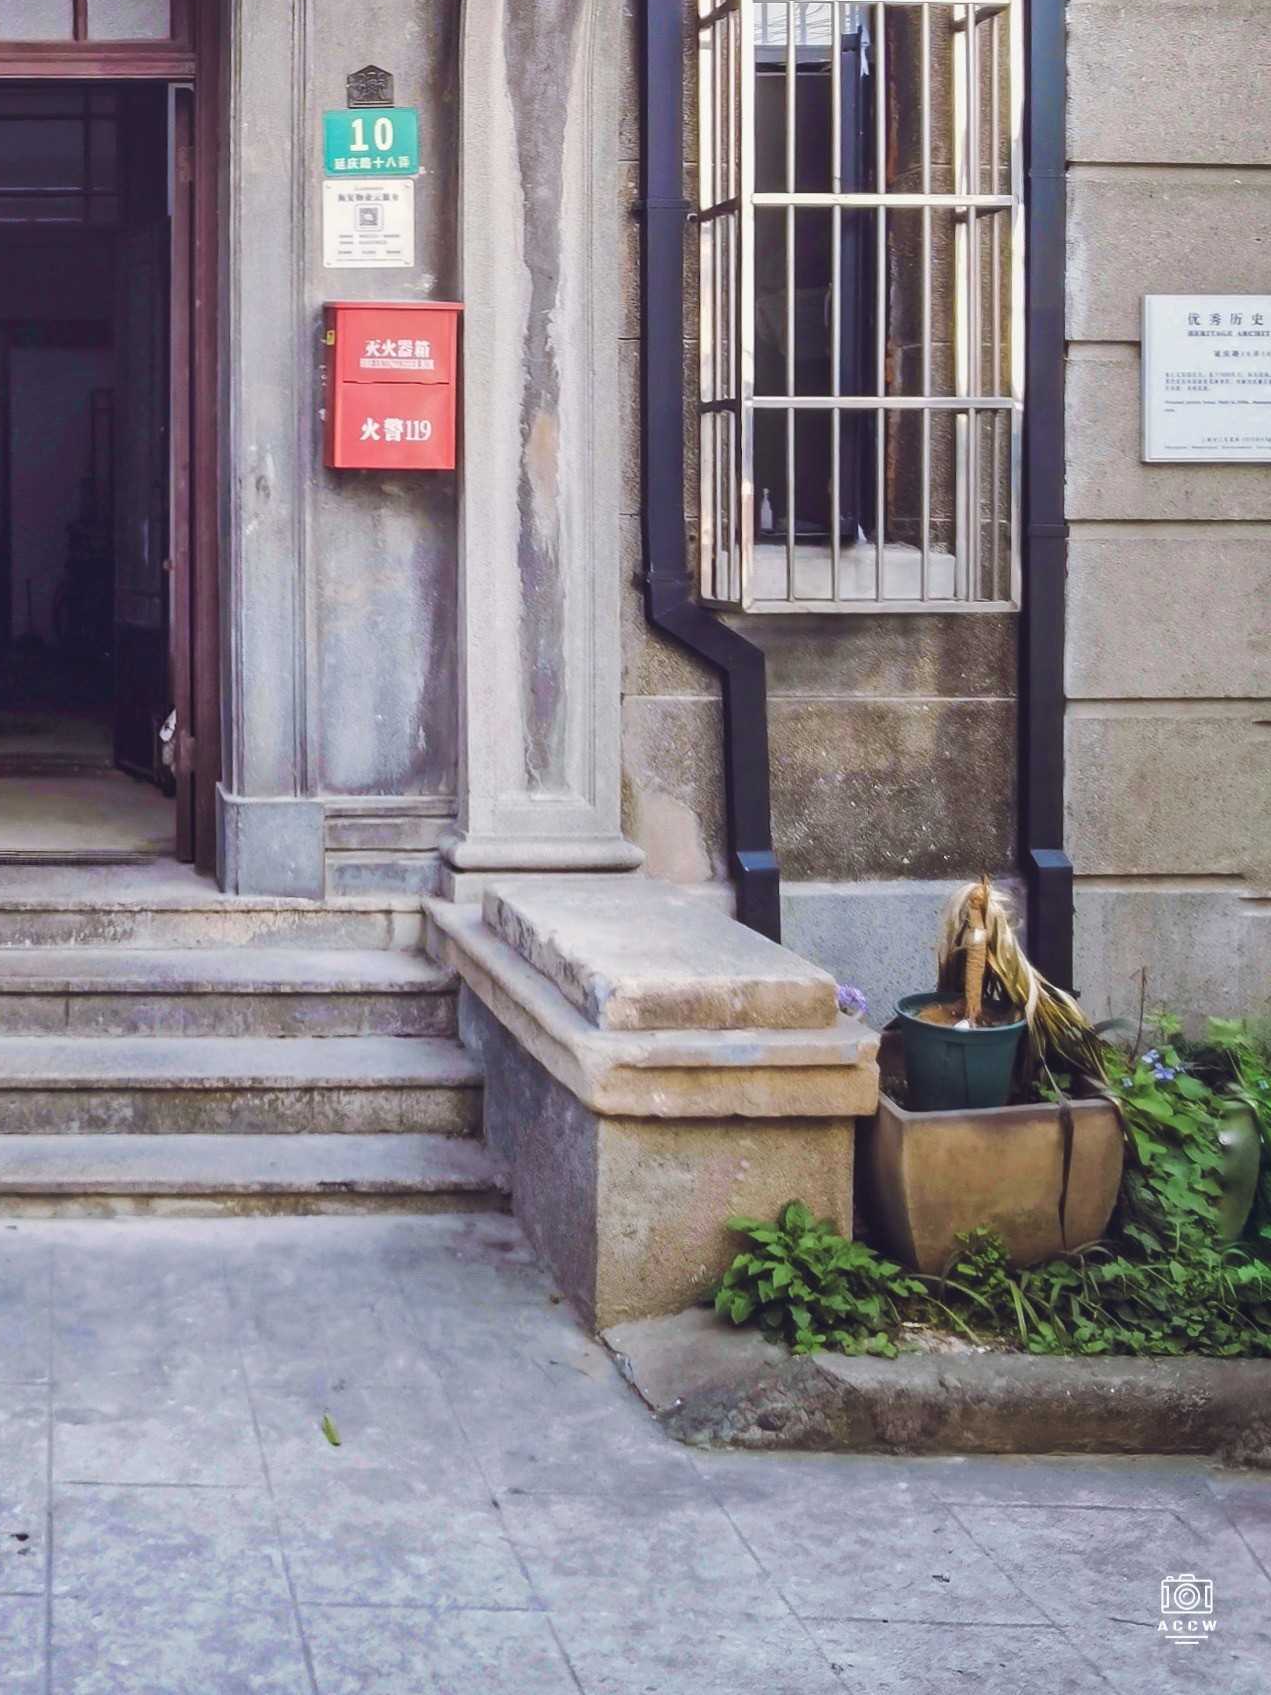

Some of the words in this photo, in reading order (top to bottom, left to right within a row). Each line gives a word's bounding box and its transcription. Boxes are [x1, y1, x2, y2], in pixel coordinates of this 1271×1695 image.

[350, 117, 393, 151] 10
[365, 339, 430, 358] 灭火器箱
[360, 418, 431, 442] 火警119
